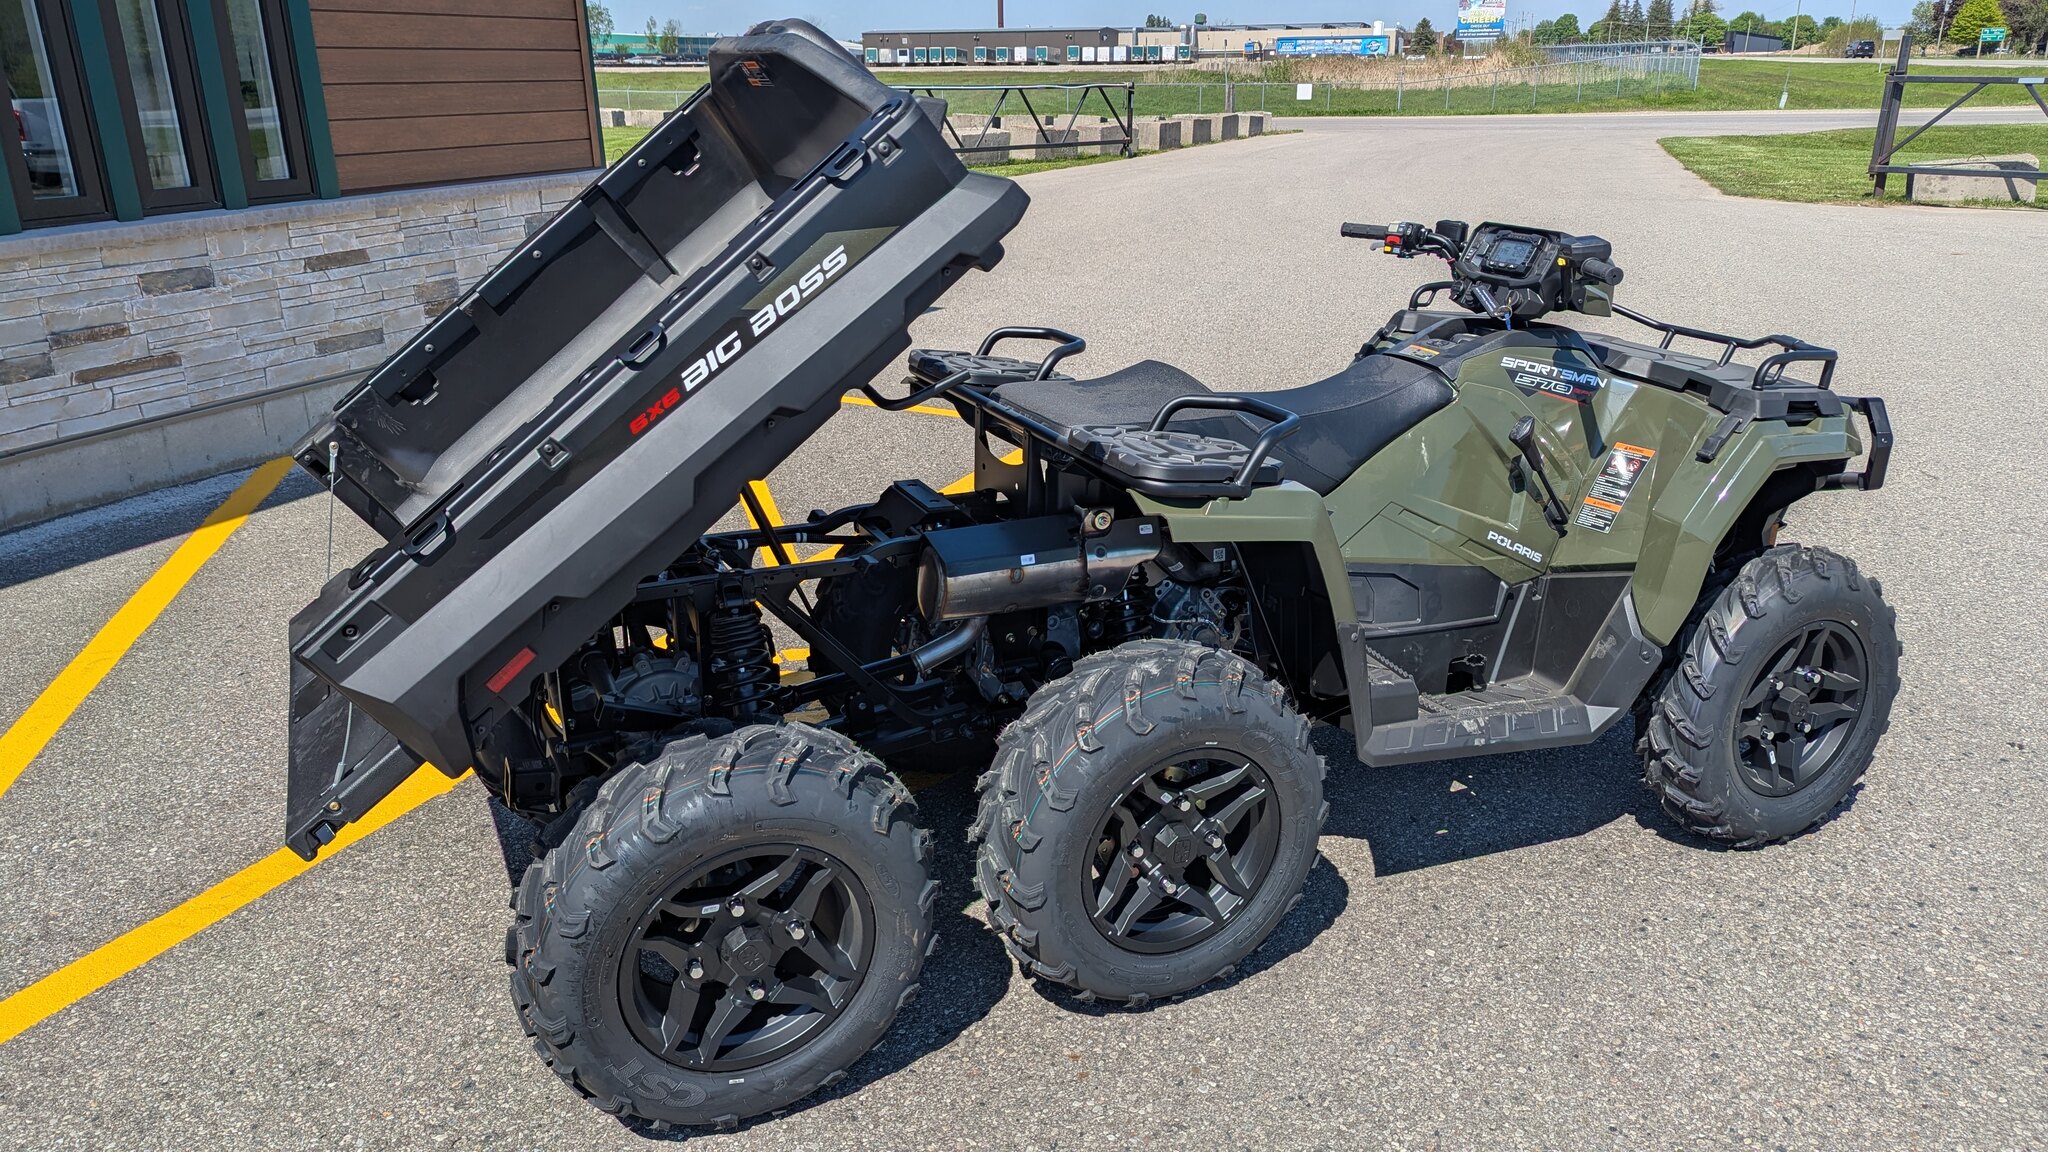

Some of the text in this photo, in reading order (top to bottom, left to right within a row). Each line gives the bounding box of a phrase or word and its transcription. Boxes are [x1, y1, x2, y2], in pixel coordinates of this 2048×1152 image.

[1460, 16, 1501, 24] CAREER?
[681, 330, 742, 392] BIG
[749, 245, 848, 338] BOSS
[1500, 356, 1608, 388] SPORTSMAN
[1514, 372, 1573, 395] 570
[1487, 530, 1543, 563] POLARIS
[601, 1056, 707, 1109] CST
